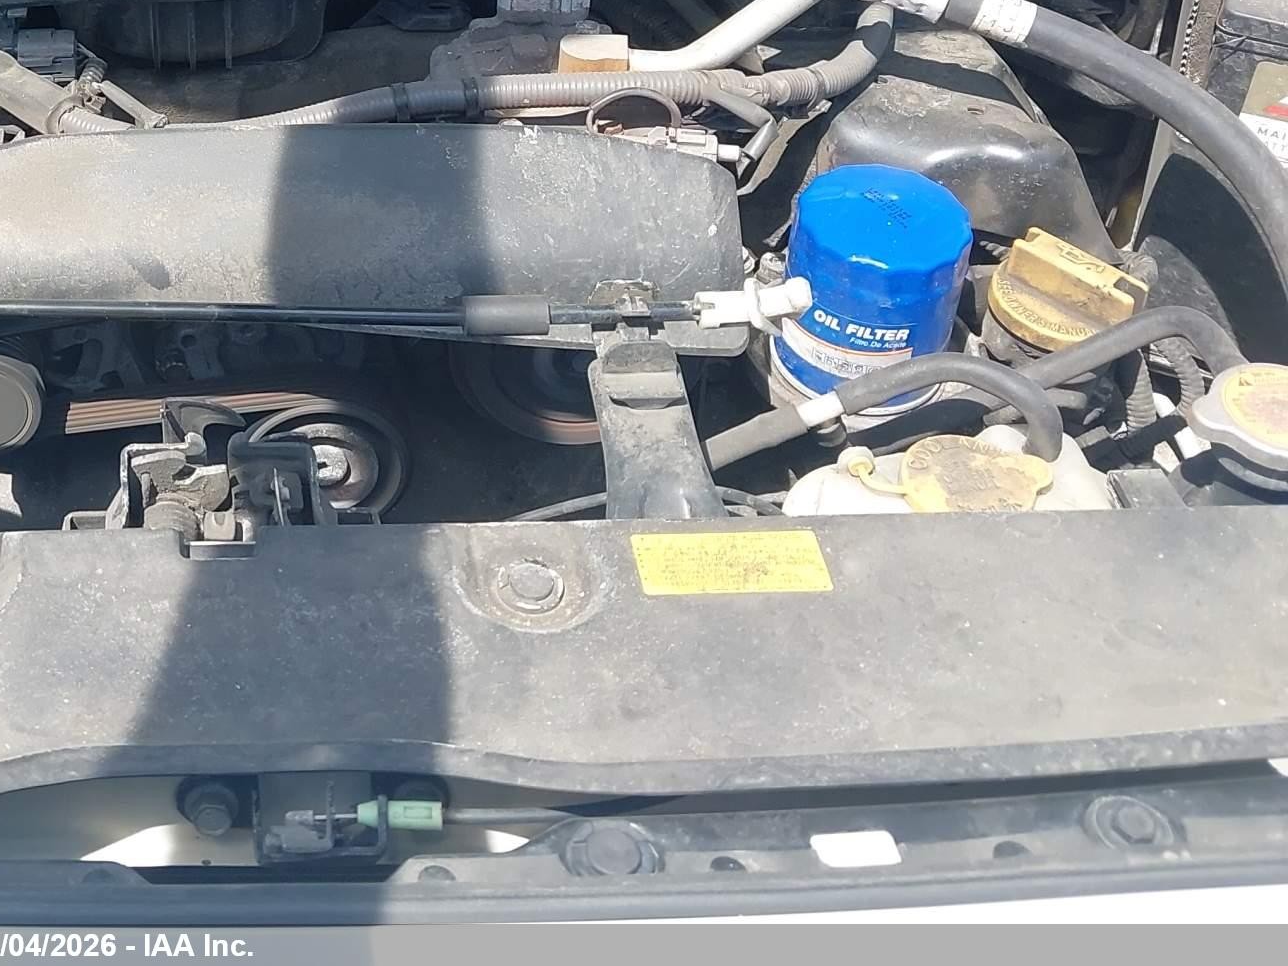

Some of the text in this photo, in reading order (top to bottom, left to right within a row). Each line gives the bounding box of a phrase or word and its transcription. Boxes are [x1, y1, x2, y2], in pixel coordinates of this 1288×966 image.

[813, 309, 910, 342] OIL FILTER
[870, 340, 882, 348] De
